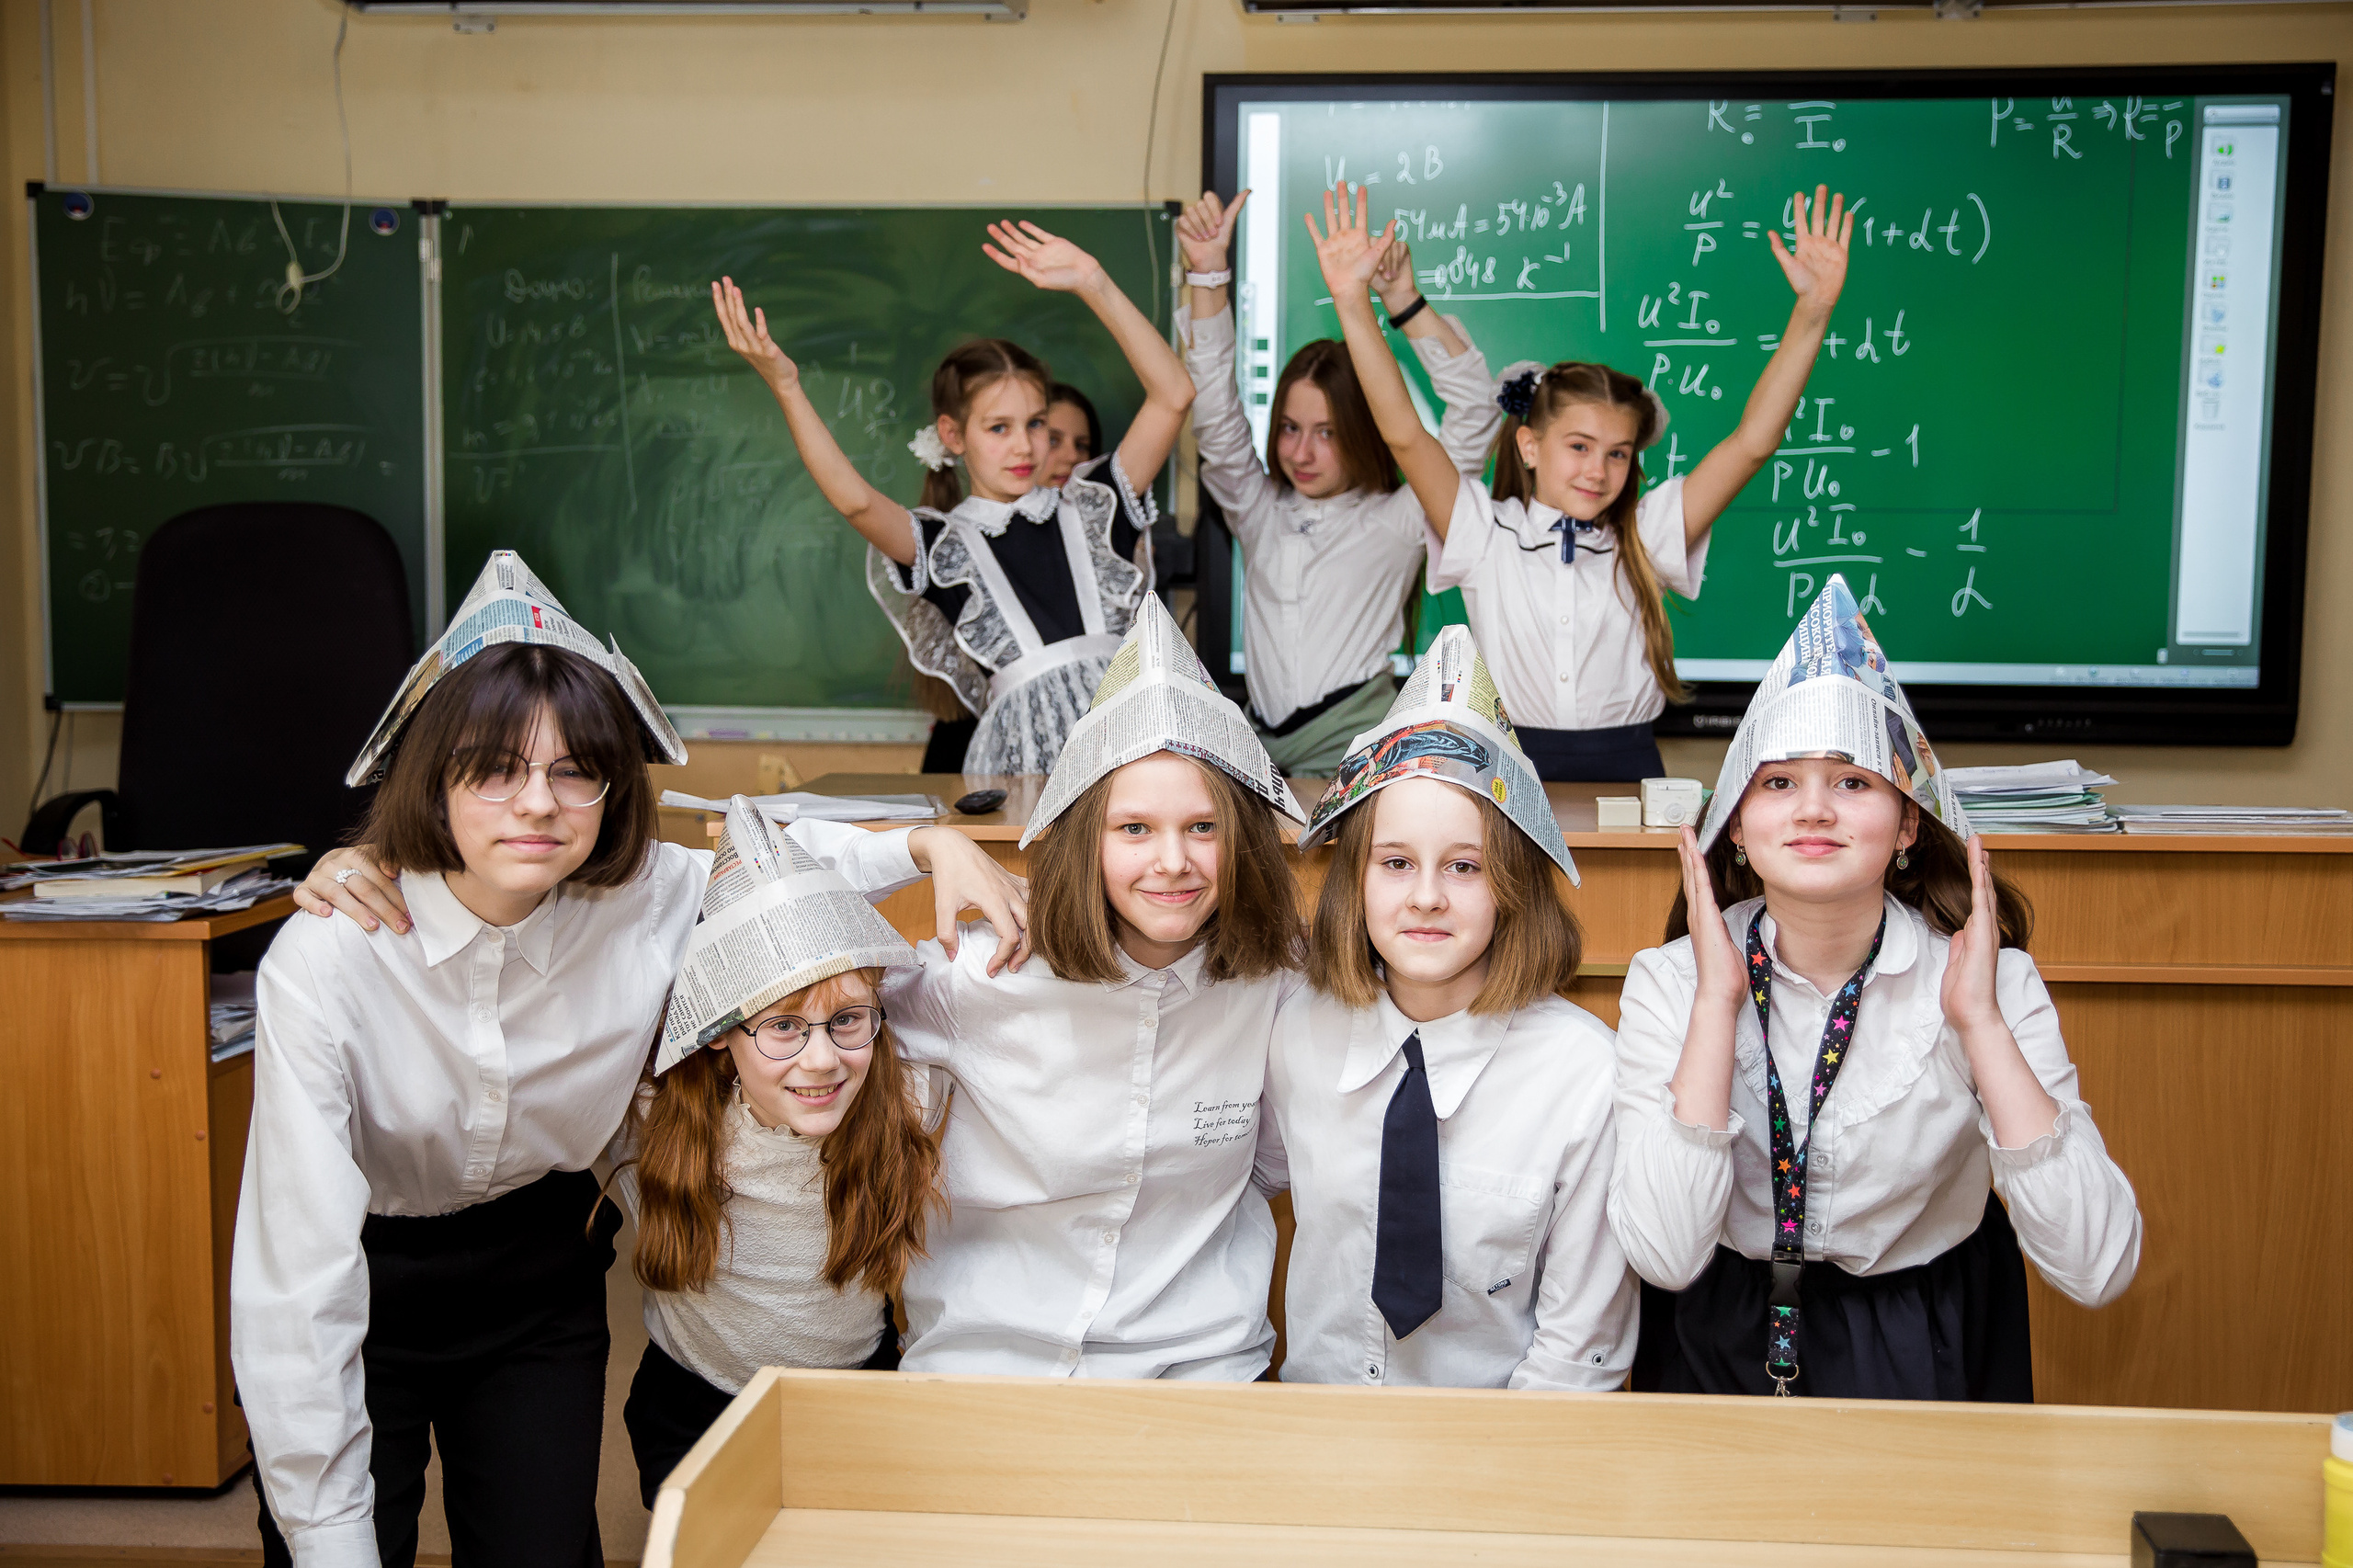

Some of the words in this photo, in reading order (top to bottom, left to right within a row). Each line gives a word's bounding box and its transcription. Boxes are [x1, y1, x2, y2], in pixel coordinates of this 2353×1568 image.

[1193, 1101, 1221, 1113] Learn
[1220, 1100, 1240, 1114] from
[1193, 1118, 1214, 1130] Live
[1213, 1117, 1226, 1131] for
[1227, 1115, 1251, 1128] today
[1219, 1132, 1233, 1146] for
